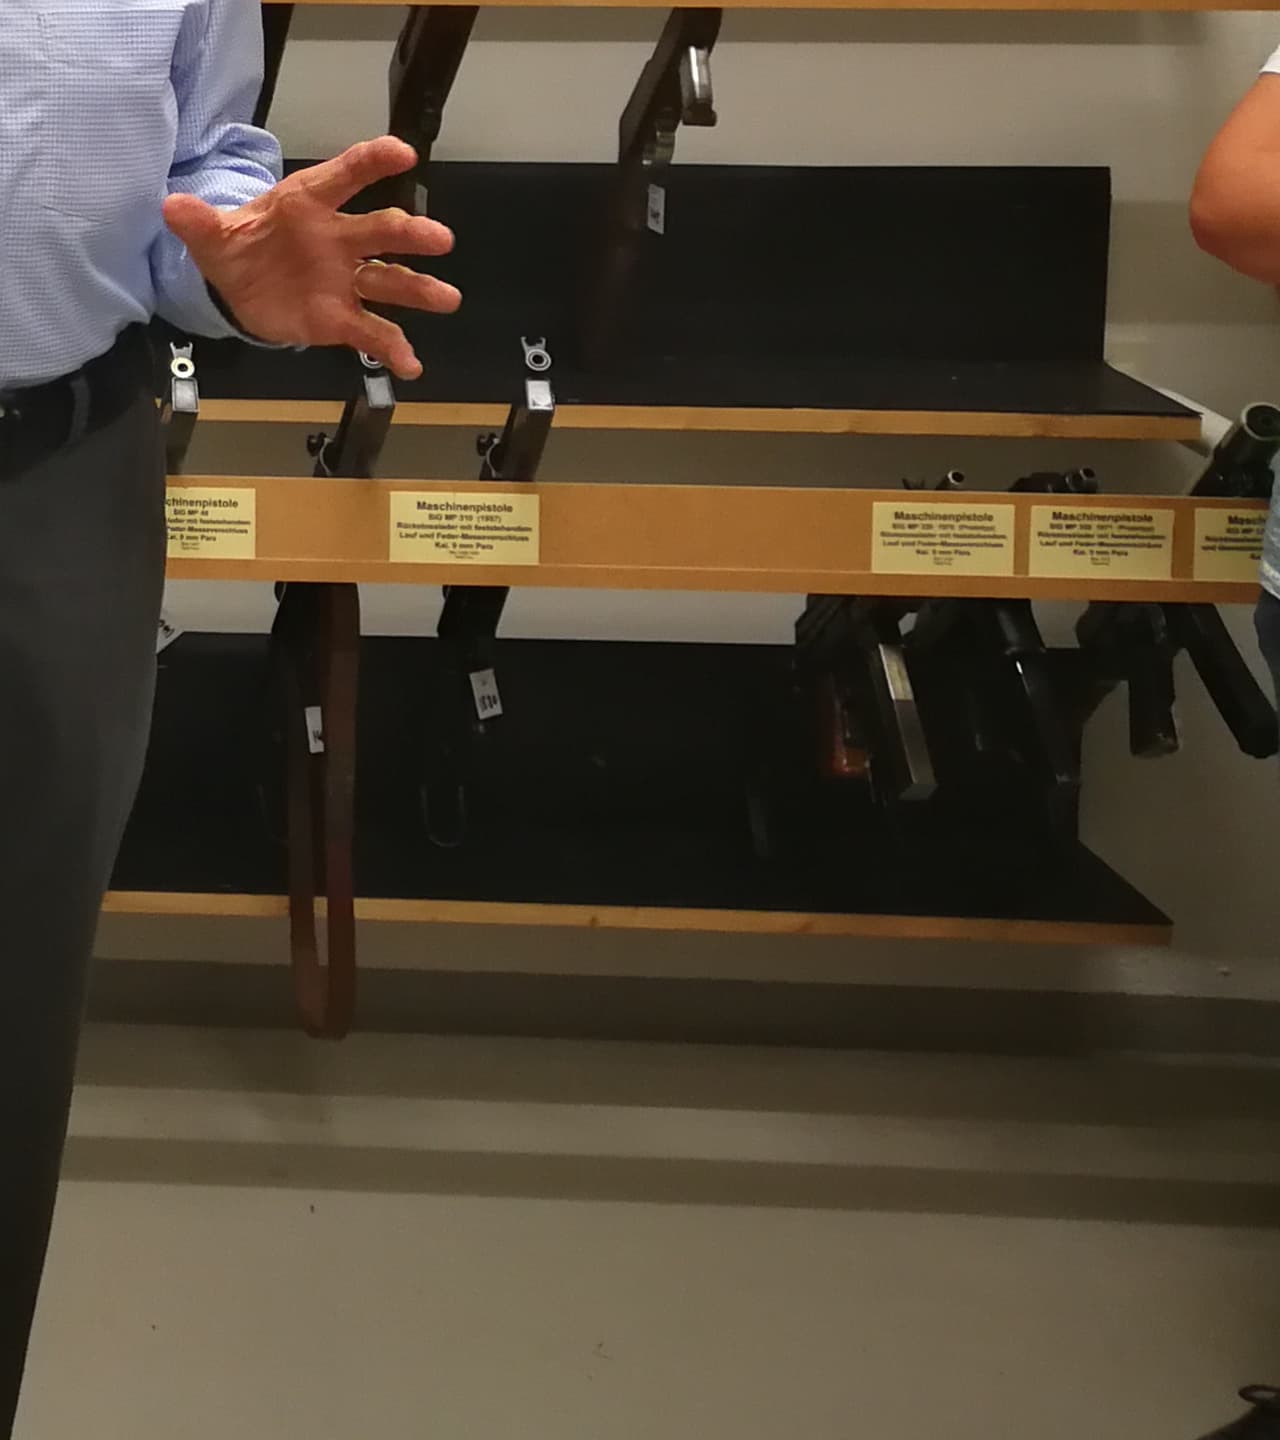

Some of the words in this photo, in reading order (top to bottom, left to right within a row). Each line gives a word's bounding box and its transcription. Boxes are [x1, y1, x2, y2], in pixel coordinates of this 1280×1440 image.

[416, 501, 513, 513] Maschinenpistole
[894, 511, 993, 522] Maschinenpistole
[1052, 511, 1153, 524] Maschinenpistole
